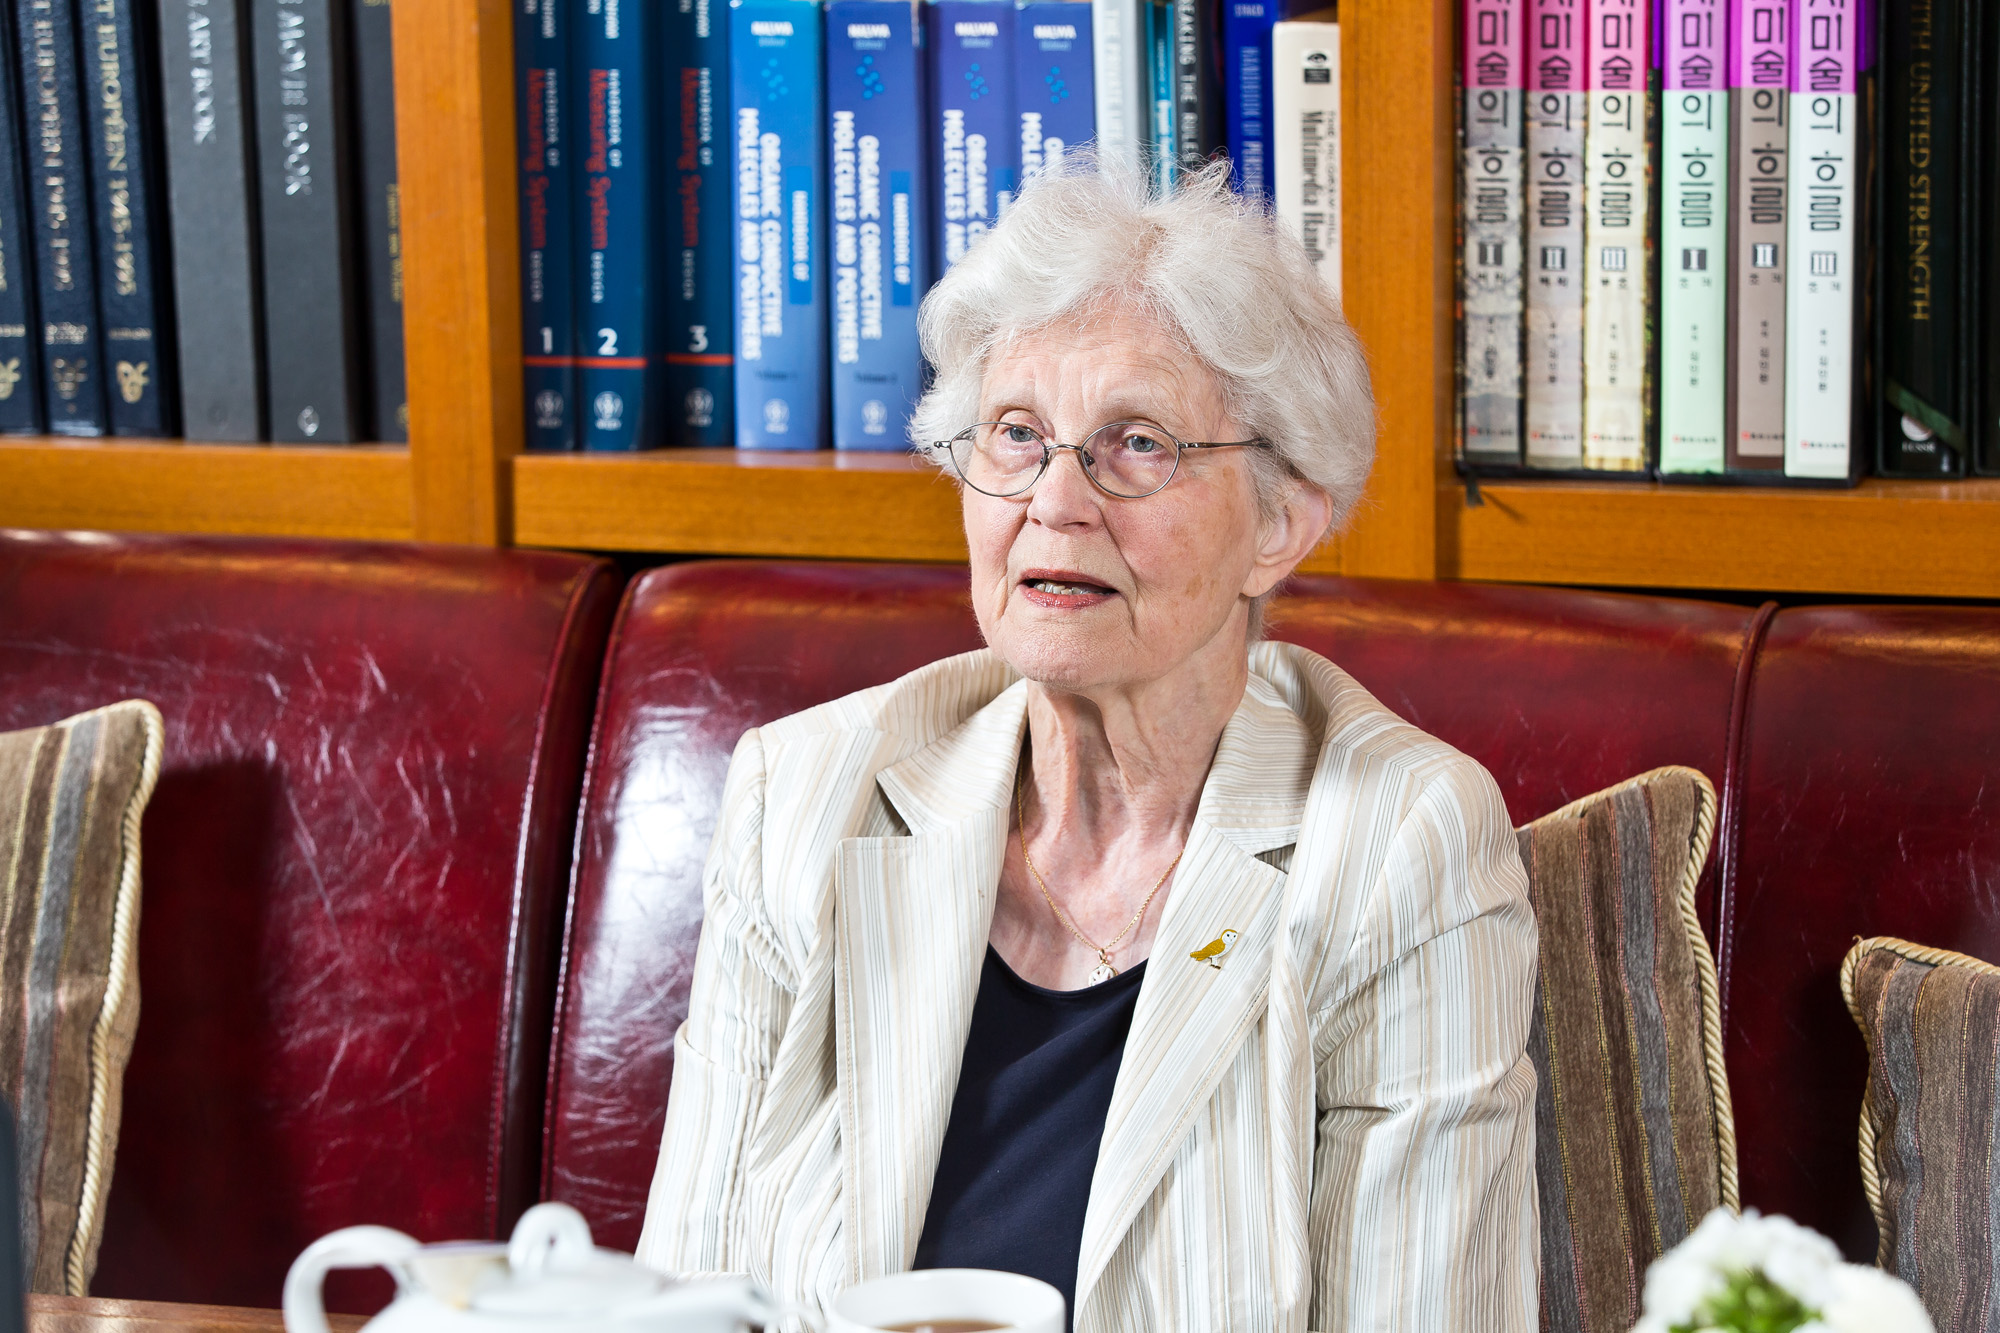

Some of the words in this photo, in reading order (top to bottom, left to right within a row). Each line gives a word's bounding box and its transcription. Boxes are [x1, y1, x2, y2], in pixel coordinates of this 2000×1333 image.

[608, 68, 621, 145] HANDBOOK
[699, 67, 712, 144] HANDBOOK
[1180, 74, 1197, 103] THE
[1476, 0, 1511, 127] 미술의
[1538, 0, 1572, 131] 미술의
[1600, 0, 1633, 131] 미술의
[1680, 0, 1712, 130] 미술의
[1752, 0, 1785, 127] 미술의
[1809, 0, 1843, 134] 미술의
[525, 68, 547, 172] Measuring
[586, 68, 609, 172] Measuring
[677, 67, 700, 171] Measuring
[1908, 62, 1931, 169] UNITED
[738, 107, 759, 220] MOLECULES
[760, 132, 781, 219] ORGANIC
[833, 111, 856, 222] MOLECULES
[858, 135, 880, 221] ORGANIC
[943, 109, 965, 221] MOLECULES
[965, 133, 988, 219] ORGANIC
[1476, 143, 1511, 223] 흐름
[1538, 148, 1573, 227] 흐름
[1600, 148, 1633, 227] 흐름
[1680, 148, 1713, 227] 흐름
[1750, 142, 1785, 224] 흐름
[1808, 151, 1843, 231] 흐름
[526, 176, 549, 249] System
[586, 176, 611, 250] System
[677, 175, 702, 247] System
[740, 221, 760, 262] AND
[835, 223, 856, 266] AND
[893, 192, 909, 265] HANDBOOK
[1909, 174, 1931, 320] STRENGTH
[591, 251, 604, 303] DESIGN
[741, 264, 762, 361] POLYMERS
[761, 220, 783, 338] CONDUCTIVE
[836, 267, 858, 364] POLYMERS
[859, 222, 882, 340] CONDUCTIVE
[540, 327, 553, 353] 1
[598, 328, 618, 355] 2
[689, 325, 708, 352] 3
